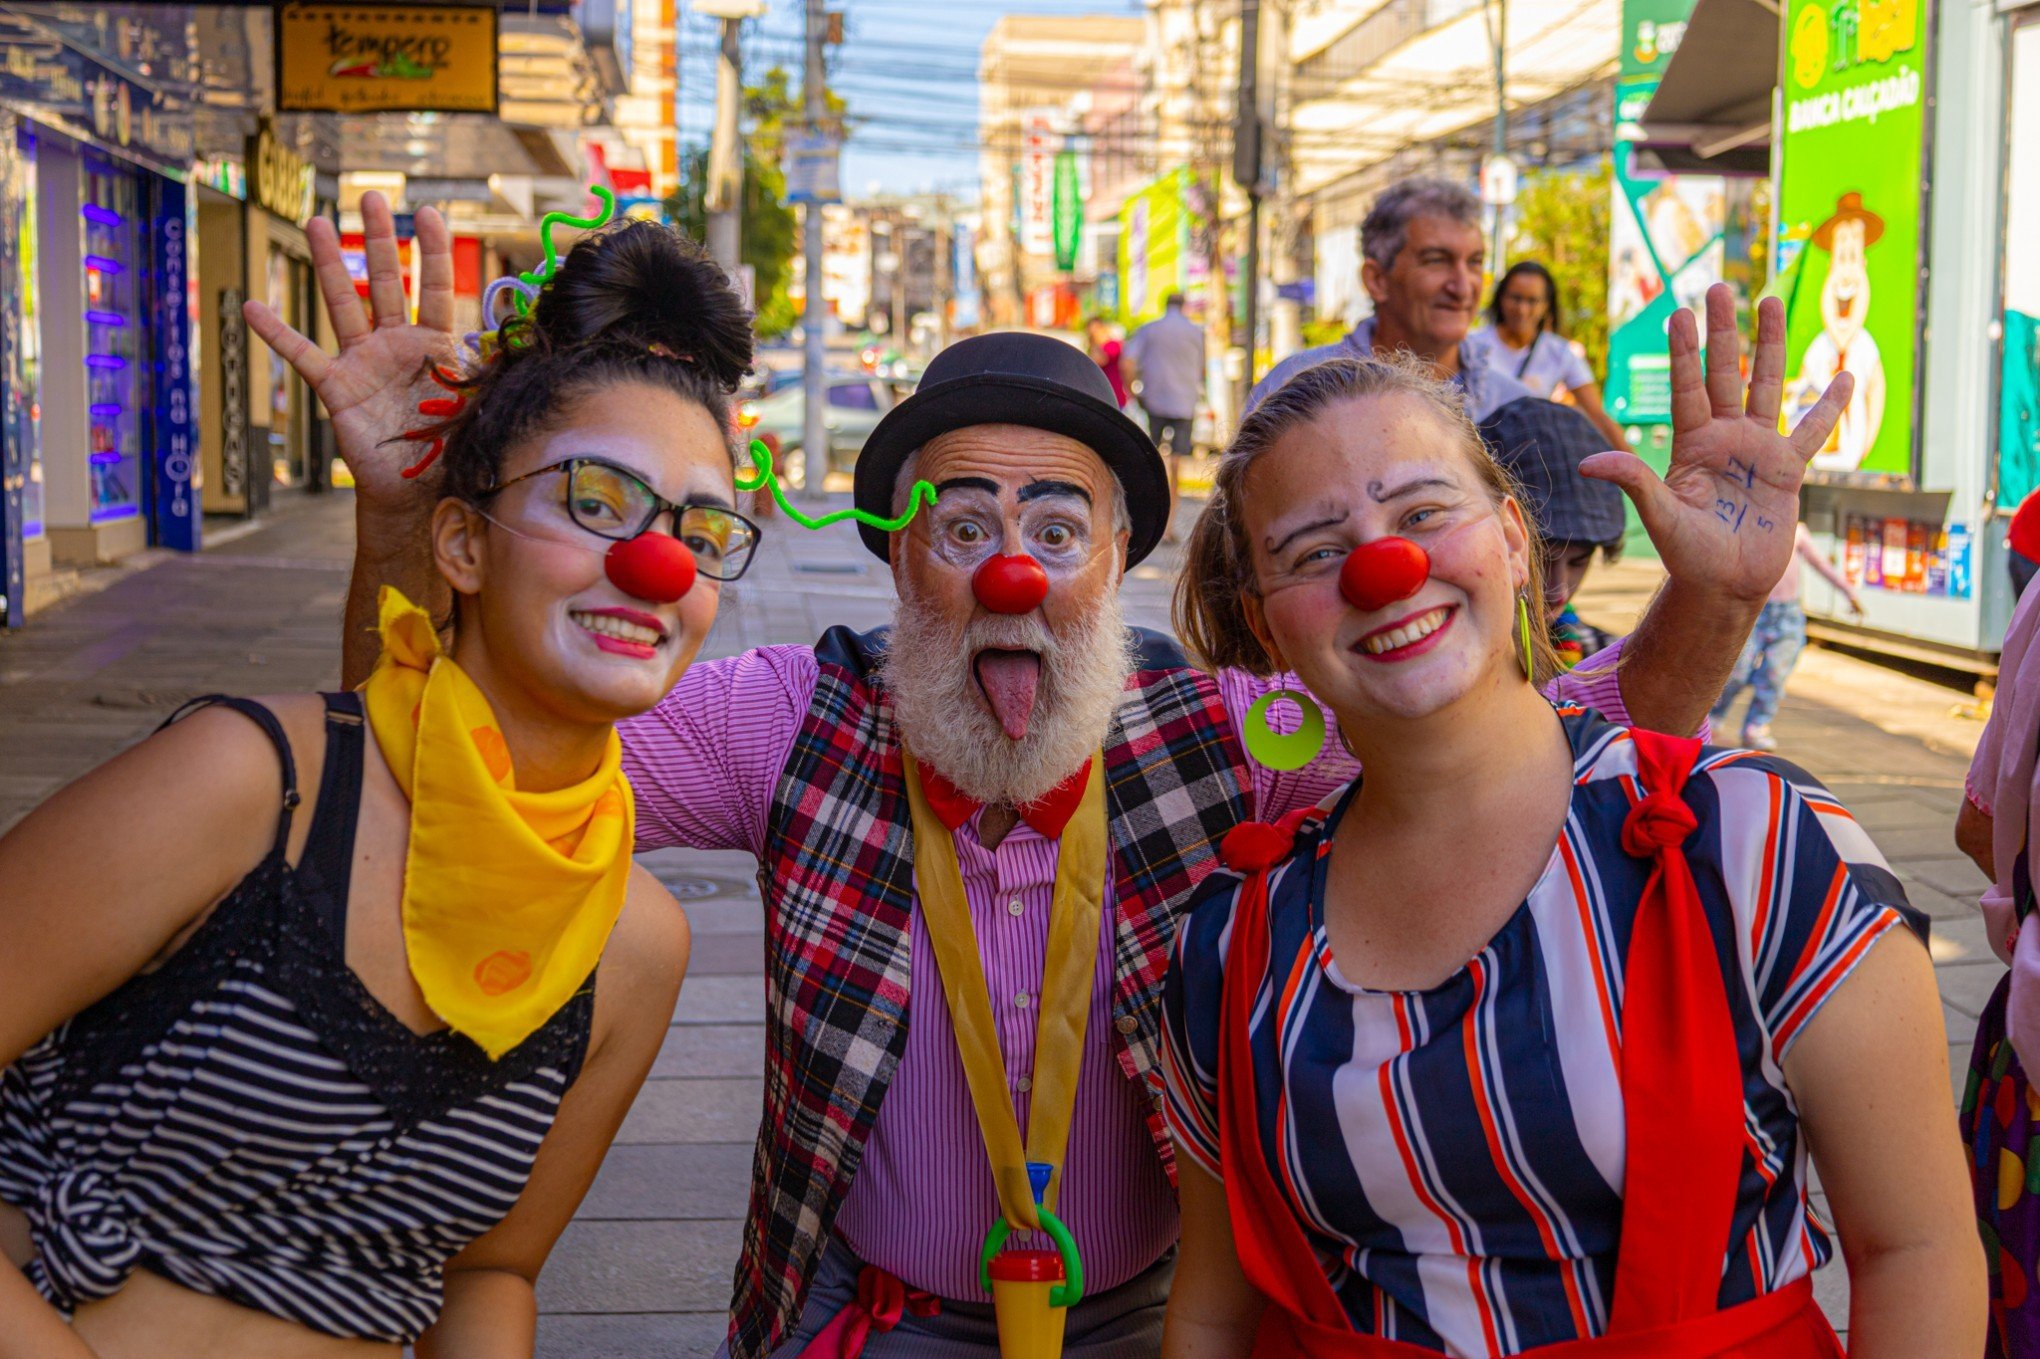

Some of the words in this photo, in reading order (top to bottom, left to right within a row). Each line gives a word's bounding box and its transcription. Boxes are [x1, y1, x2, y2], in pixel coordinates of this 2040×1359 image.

[326, 25, 451, 66] tempero
[1788, 91, 1841, 134] BANCA
[1841, 64, 1920, 125] CALÇADÃO
